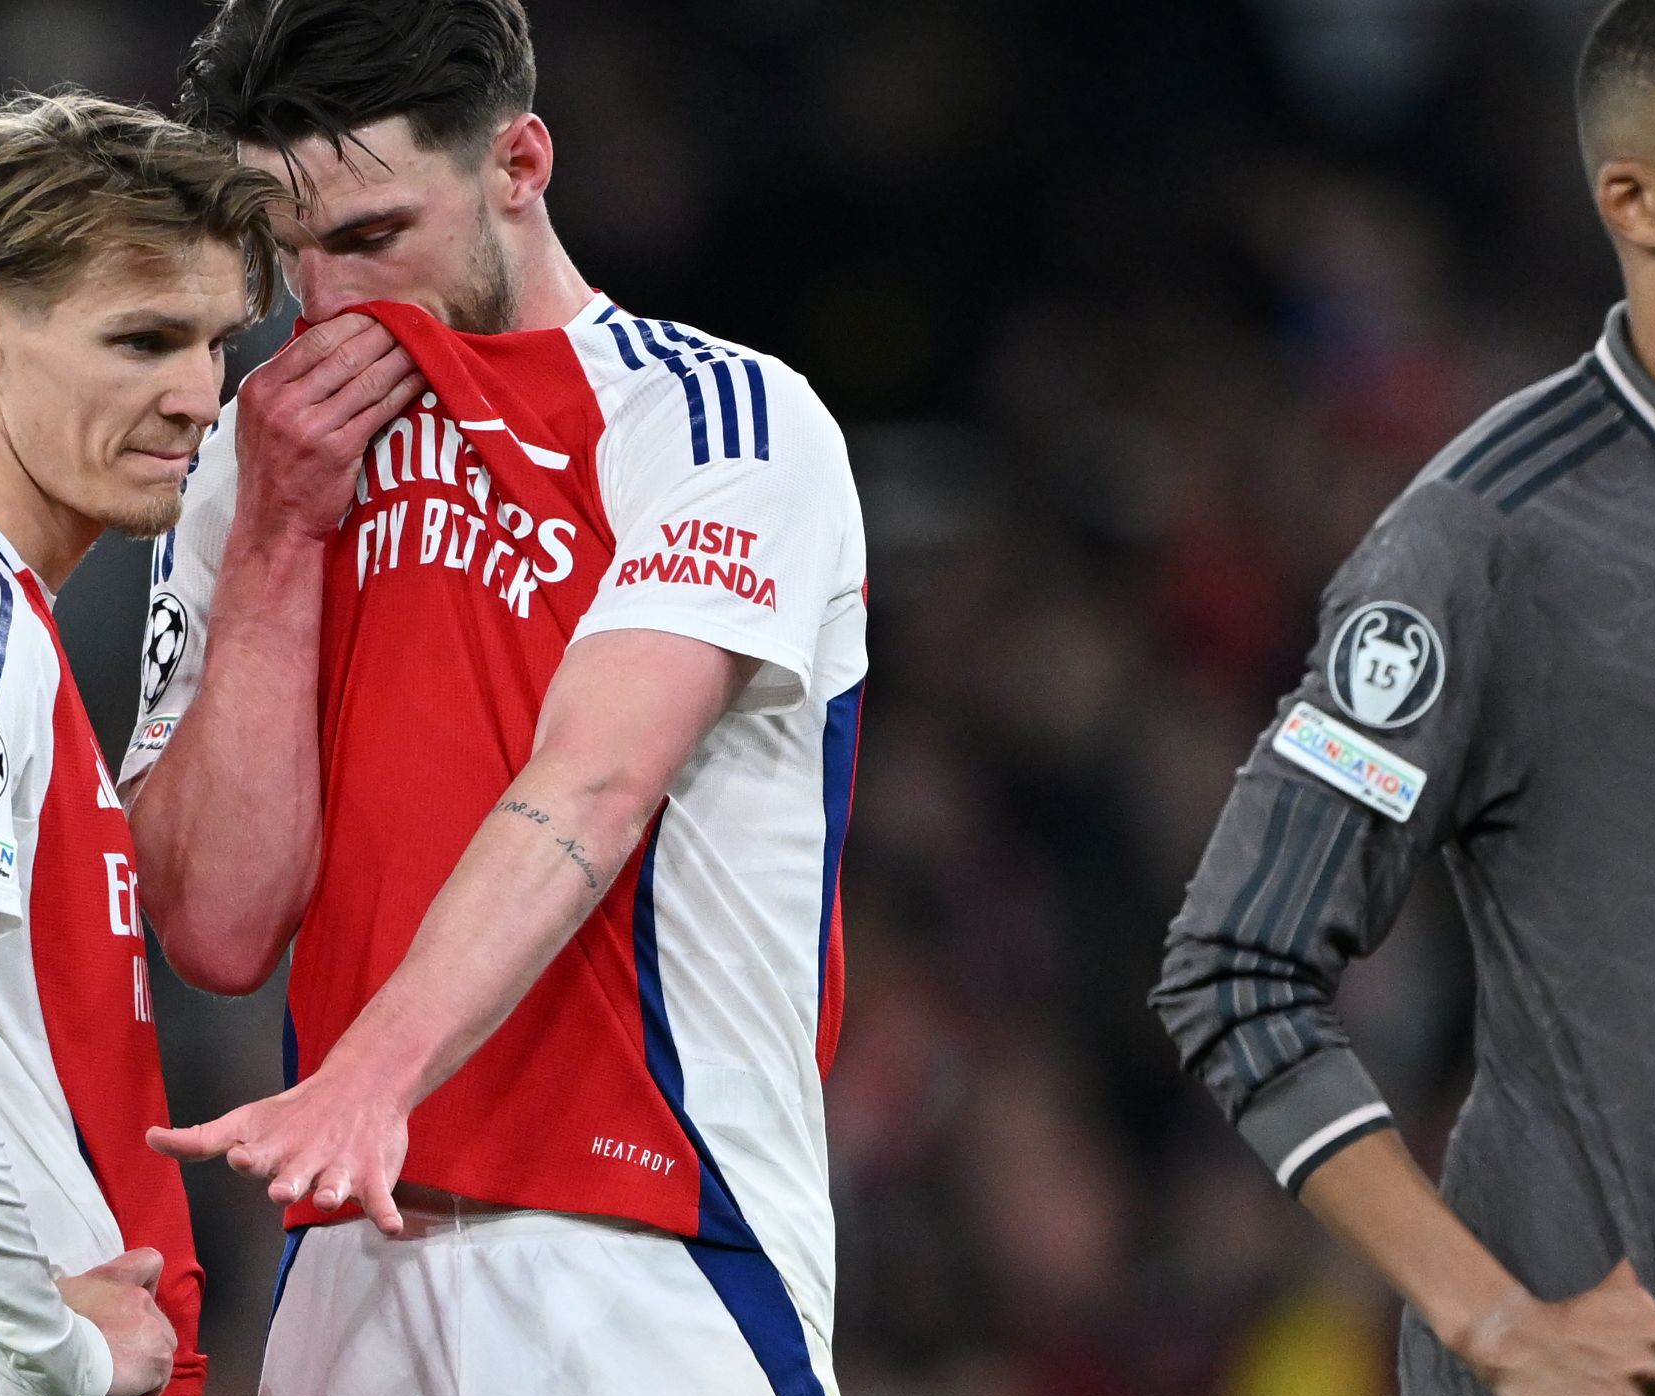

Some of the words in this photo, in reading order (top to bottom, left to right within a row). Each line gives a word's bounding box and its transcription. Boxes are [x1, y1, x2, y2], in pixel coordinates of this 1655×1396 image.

[660, 519, 758, 560] VISIT
[615, 552, 777, 613] RWANDA
[1365, 659, 1402, 690] 15
[591, 1136, 676, 1176] HEAT.RDY
